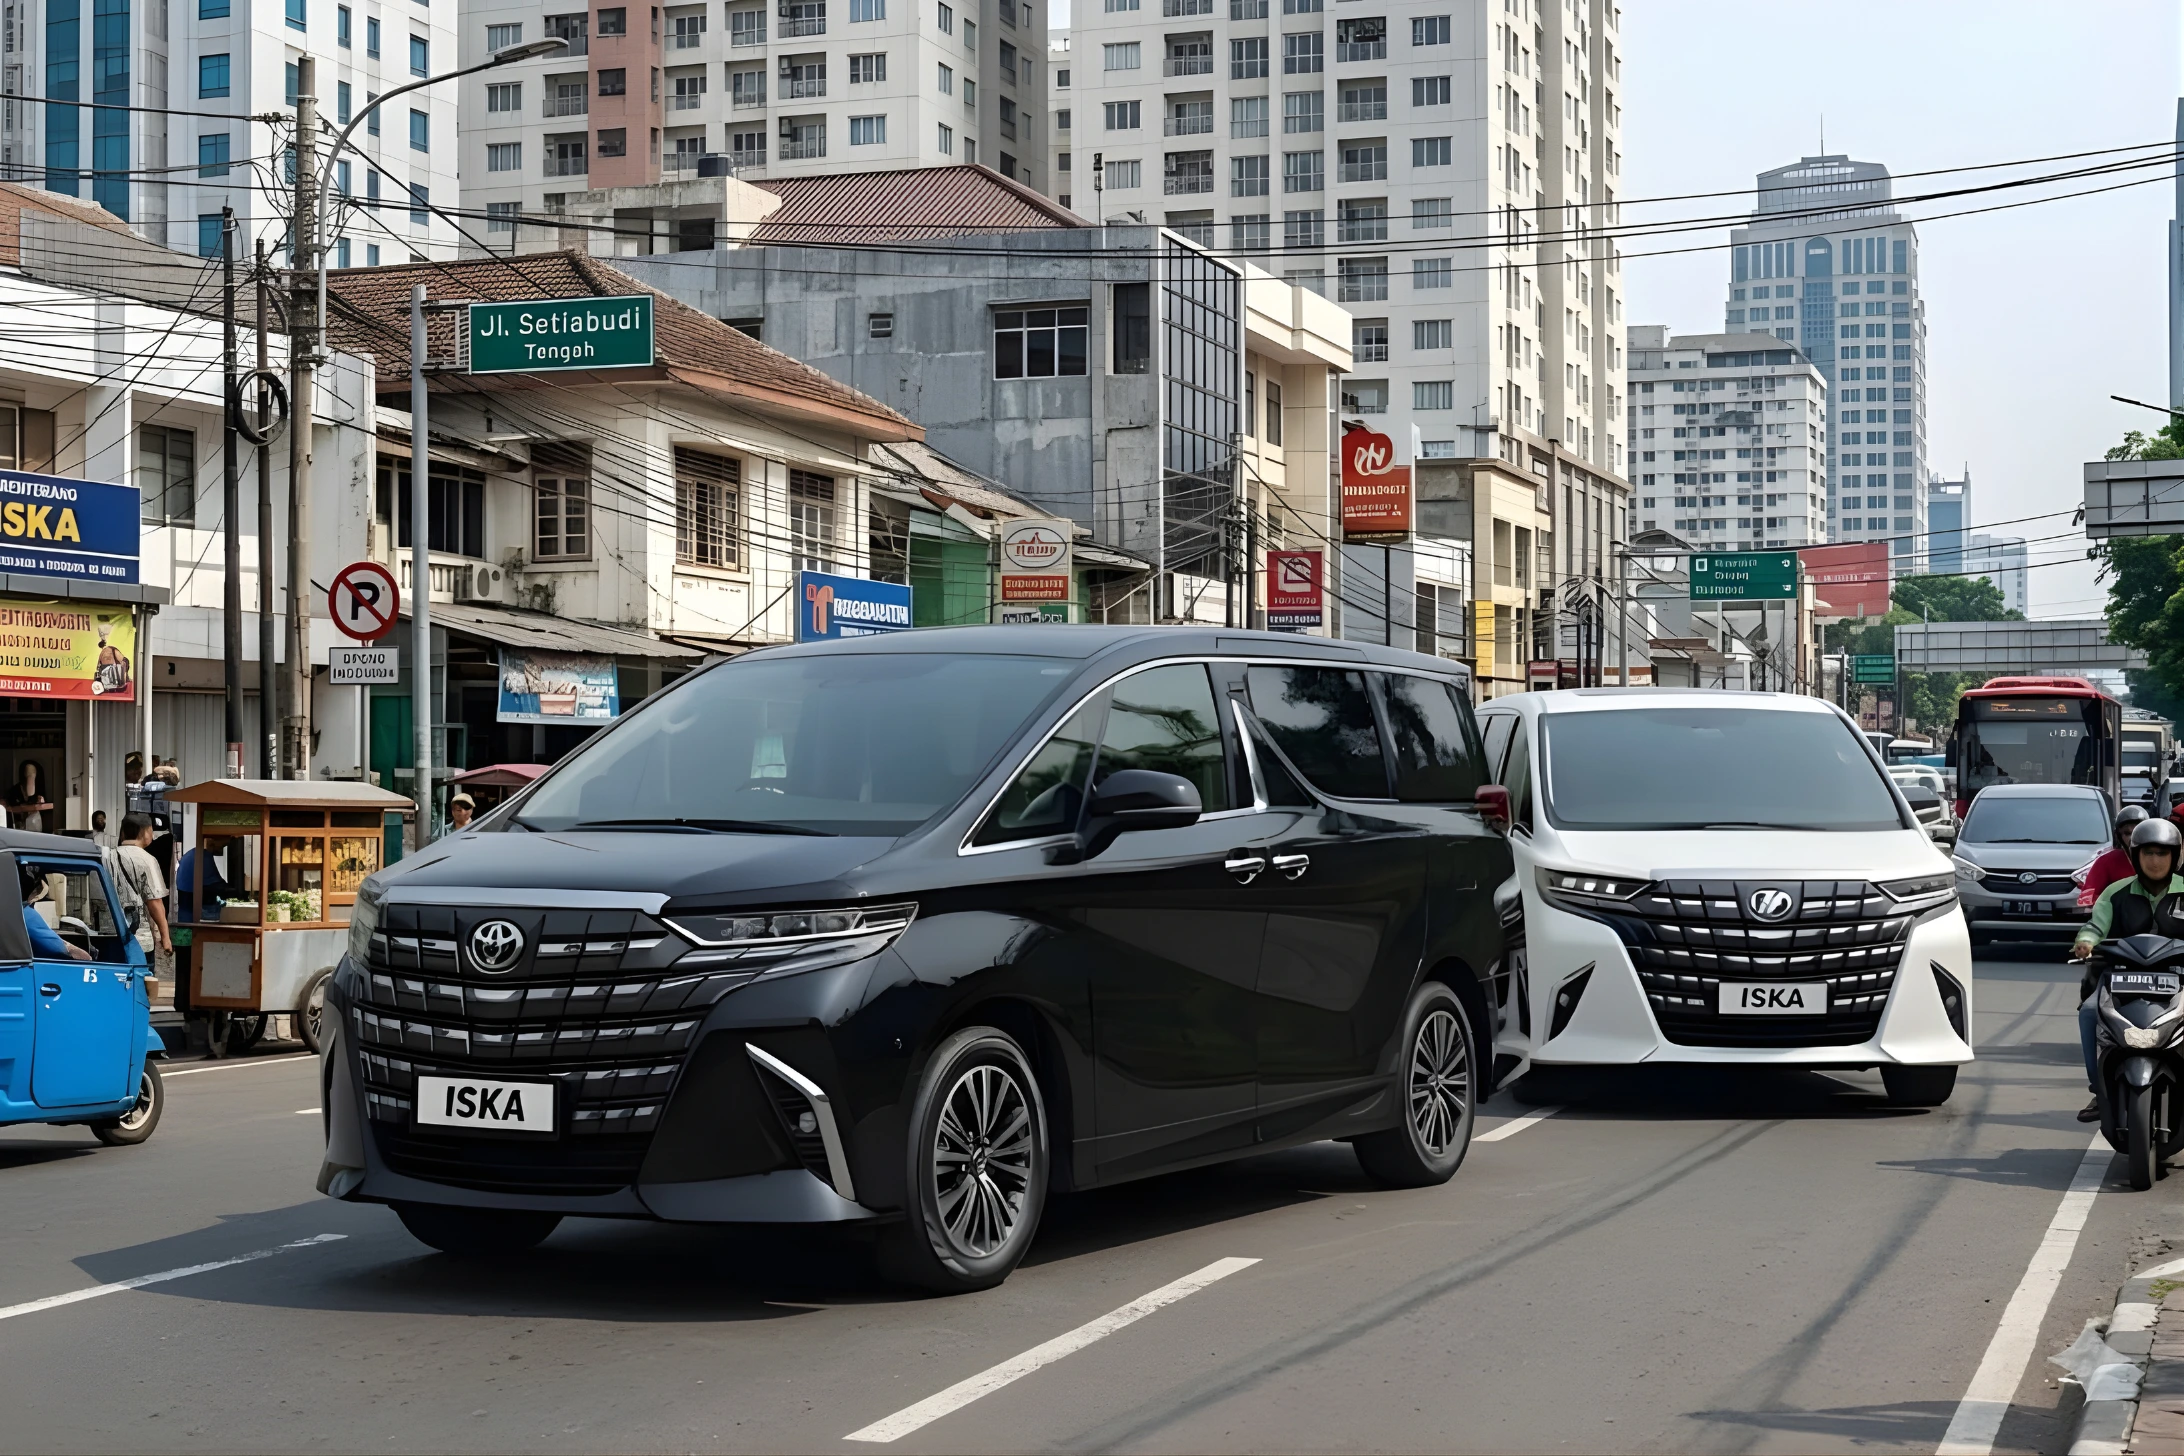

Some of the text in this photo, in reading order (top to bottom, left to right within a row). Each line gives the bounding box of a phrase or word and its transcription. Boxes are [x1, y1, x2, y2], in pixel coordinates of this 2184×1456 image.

[480, 306, 640, 337] Jl. Setiabudi
[0, 501, 81, 543] SKA
[350, 581, 380, 621] P
[1741, 987, 1805, 1009] ISKA
[445, 1085, 525, 1122] ISKA
